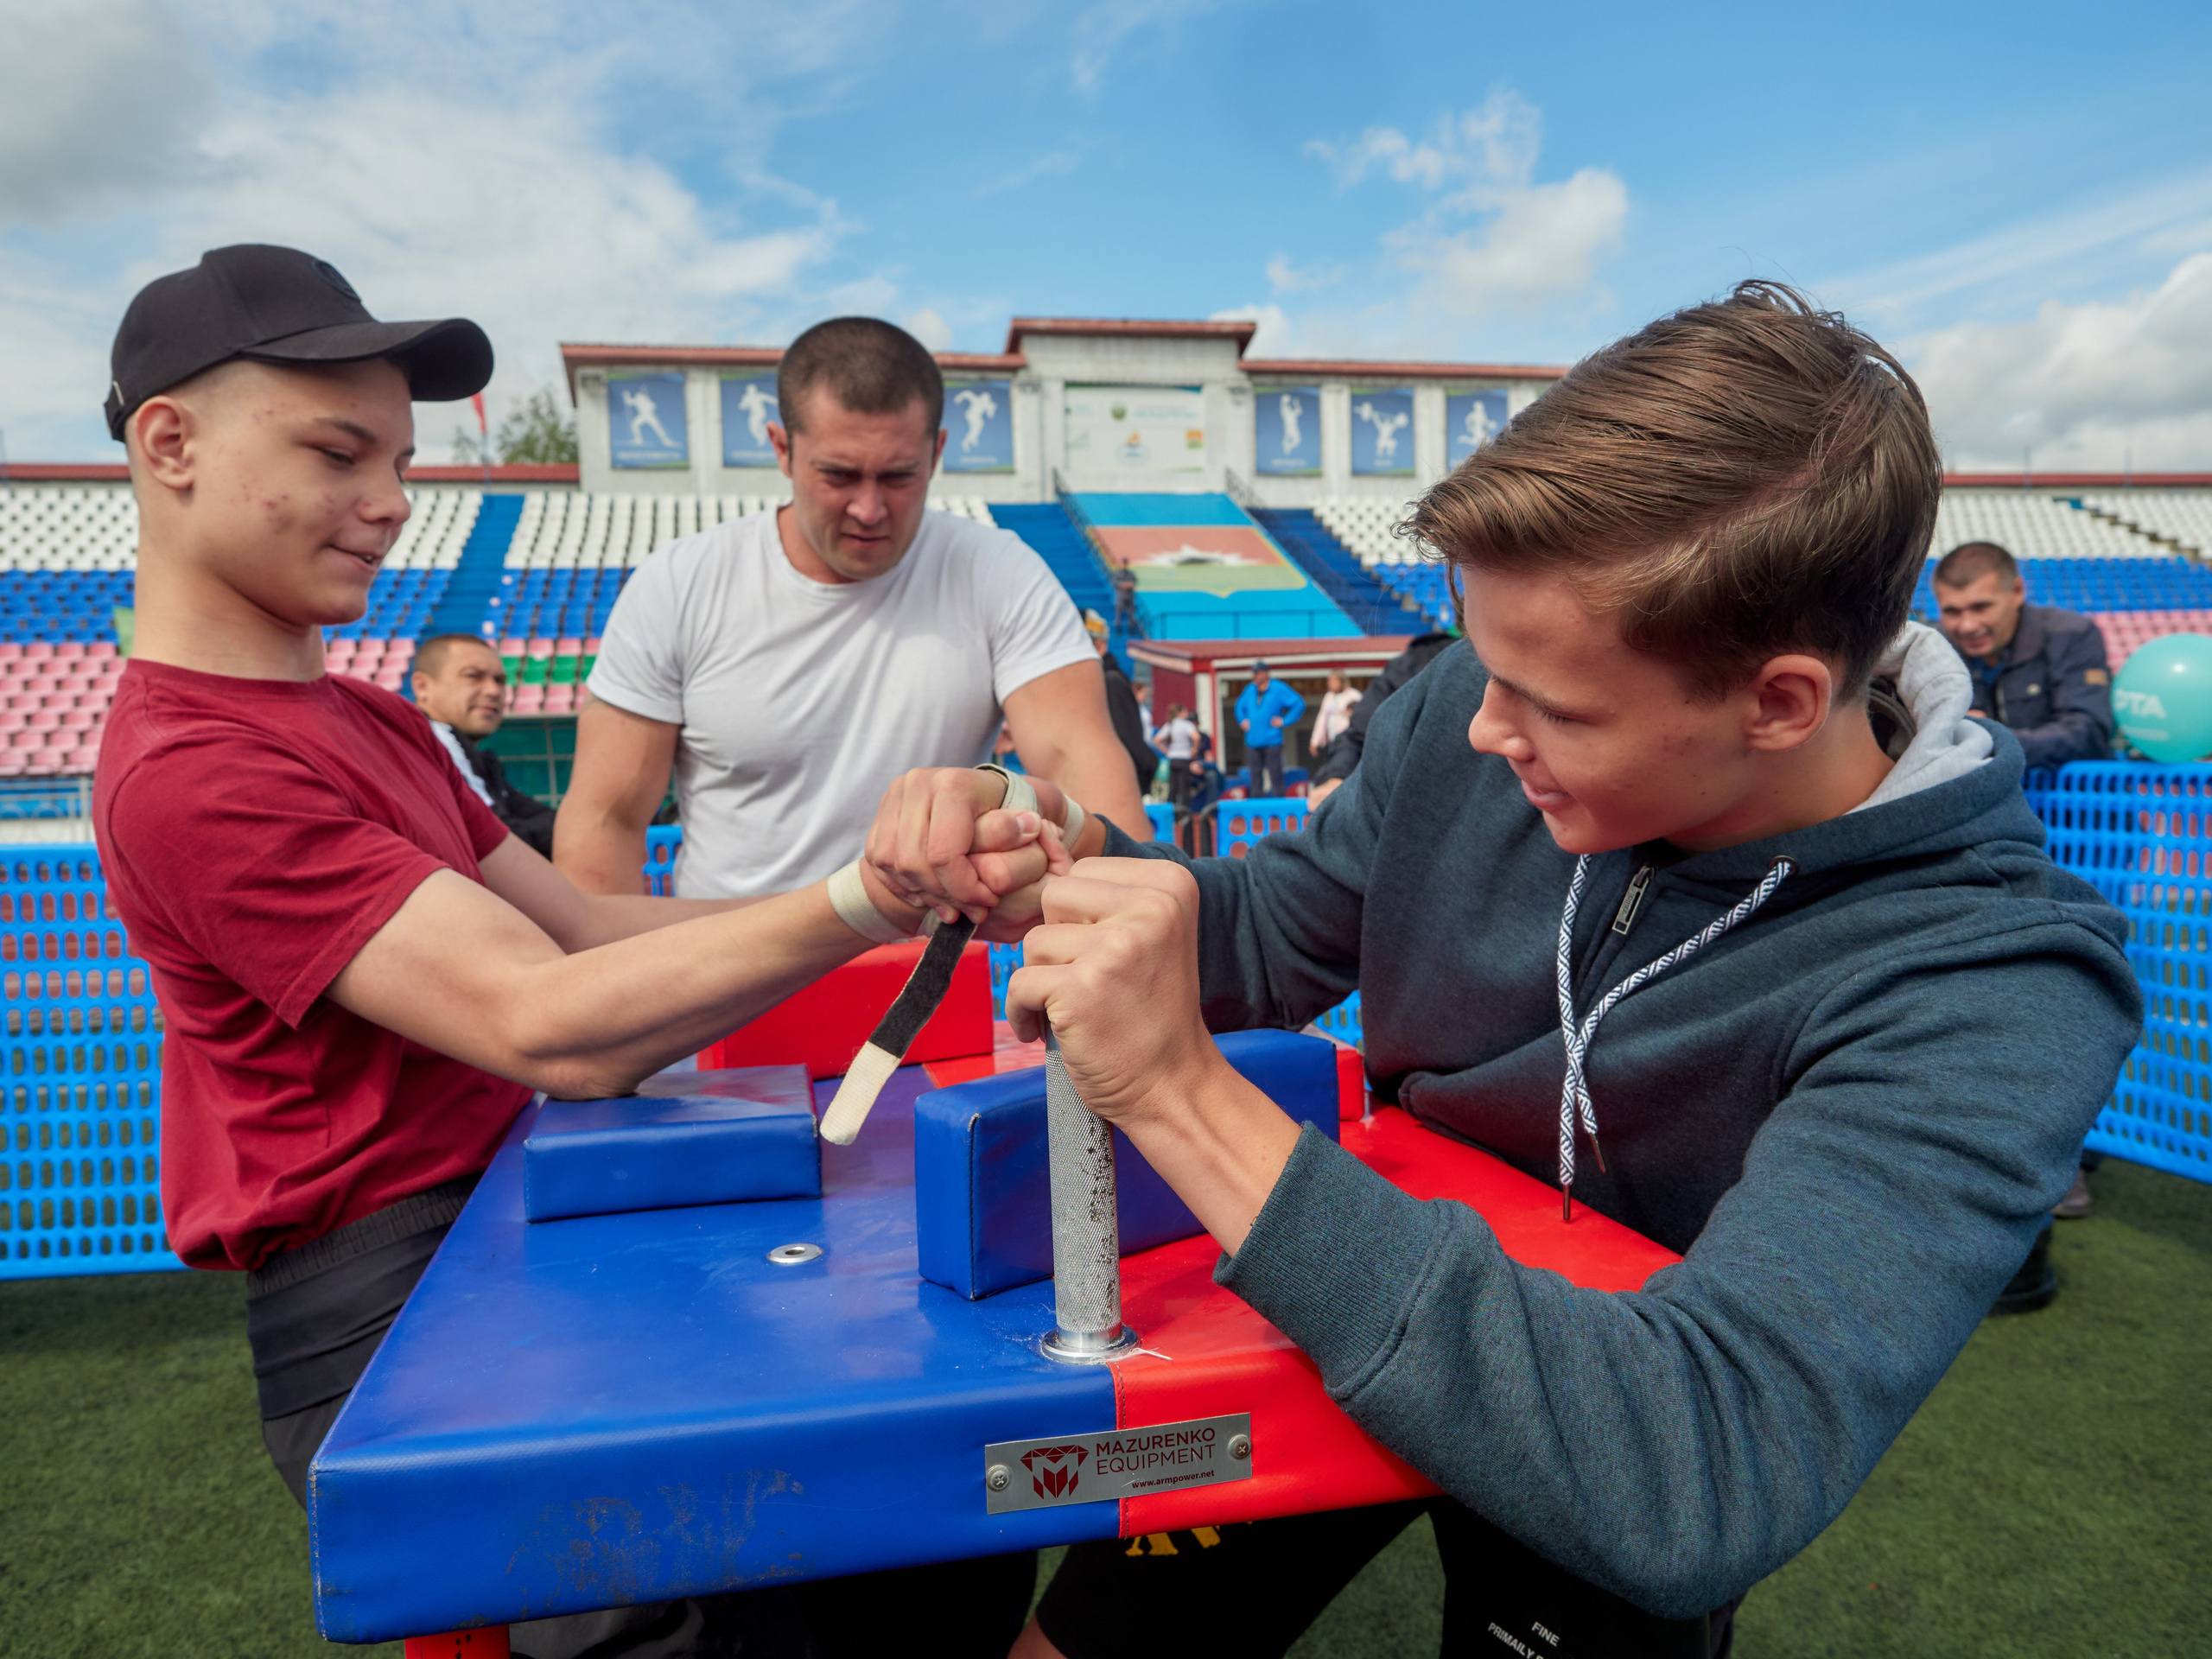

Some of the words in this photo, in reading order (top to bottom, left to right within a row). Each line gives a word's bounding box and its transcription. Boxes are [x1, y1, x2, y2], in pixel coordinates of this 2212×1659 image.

[1096, 1427, 1216, 1457] MAZURENKO
[1096, 1444, 1216, 1475] EQUIPMENT
[1132, 1470, 1215, 1489] www.armpower.net
[1487, 1621, 1536, 1659] PRIMAILY
[1530, 1621, 1560, 1647] FINE
